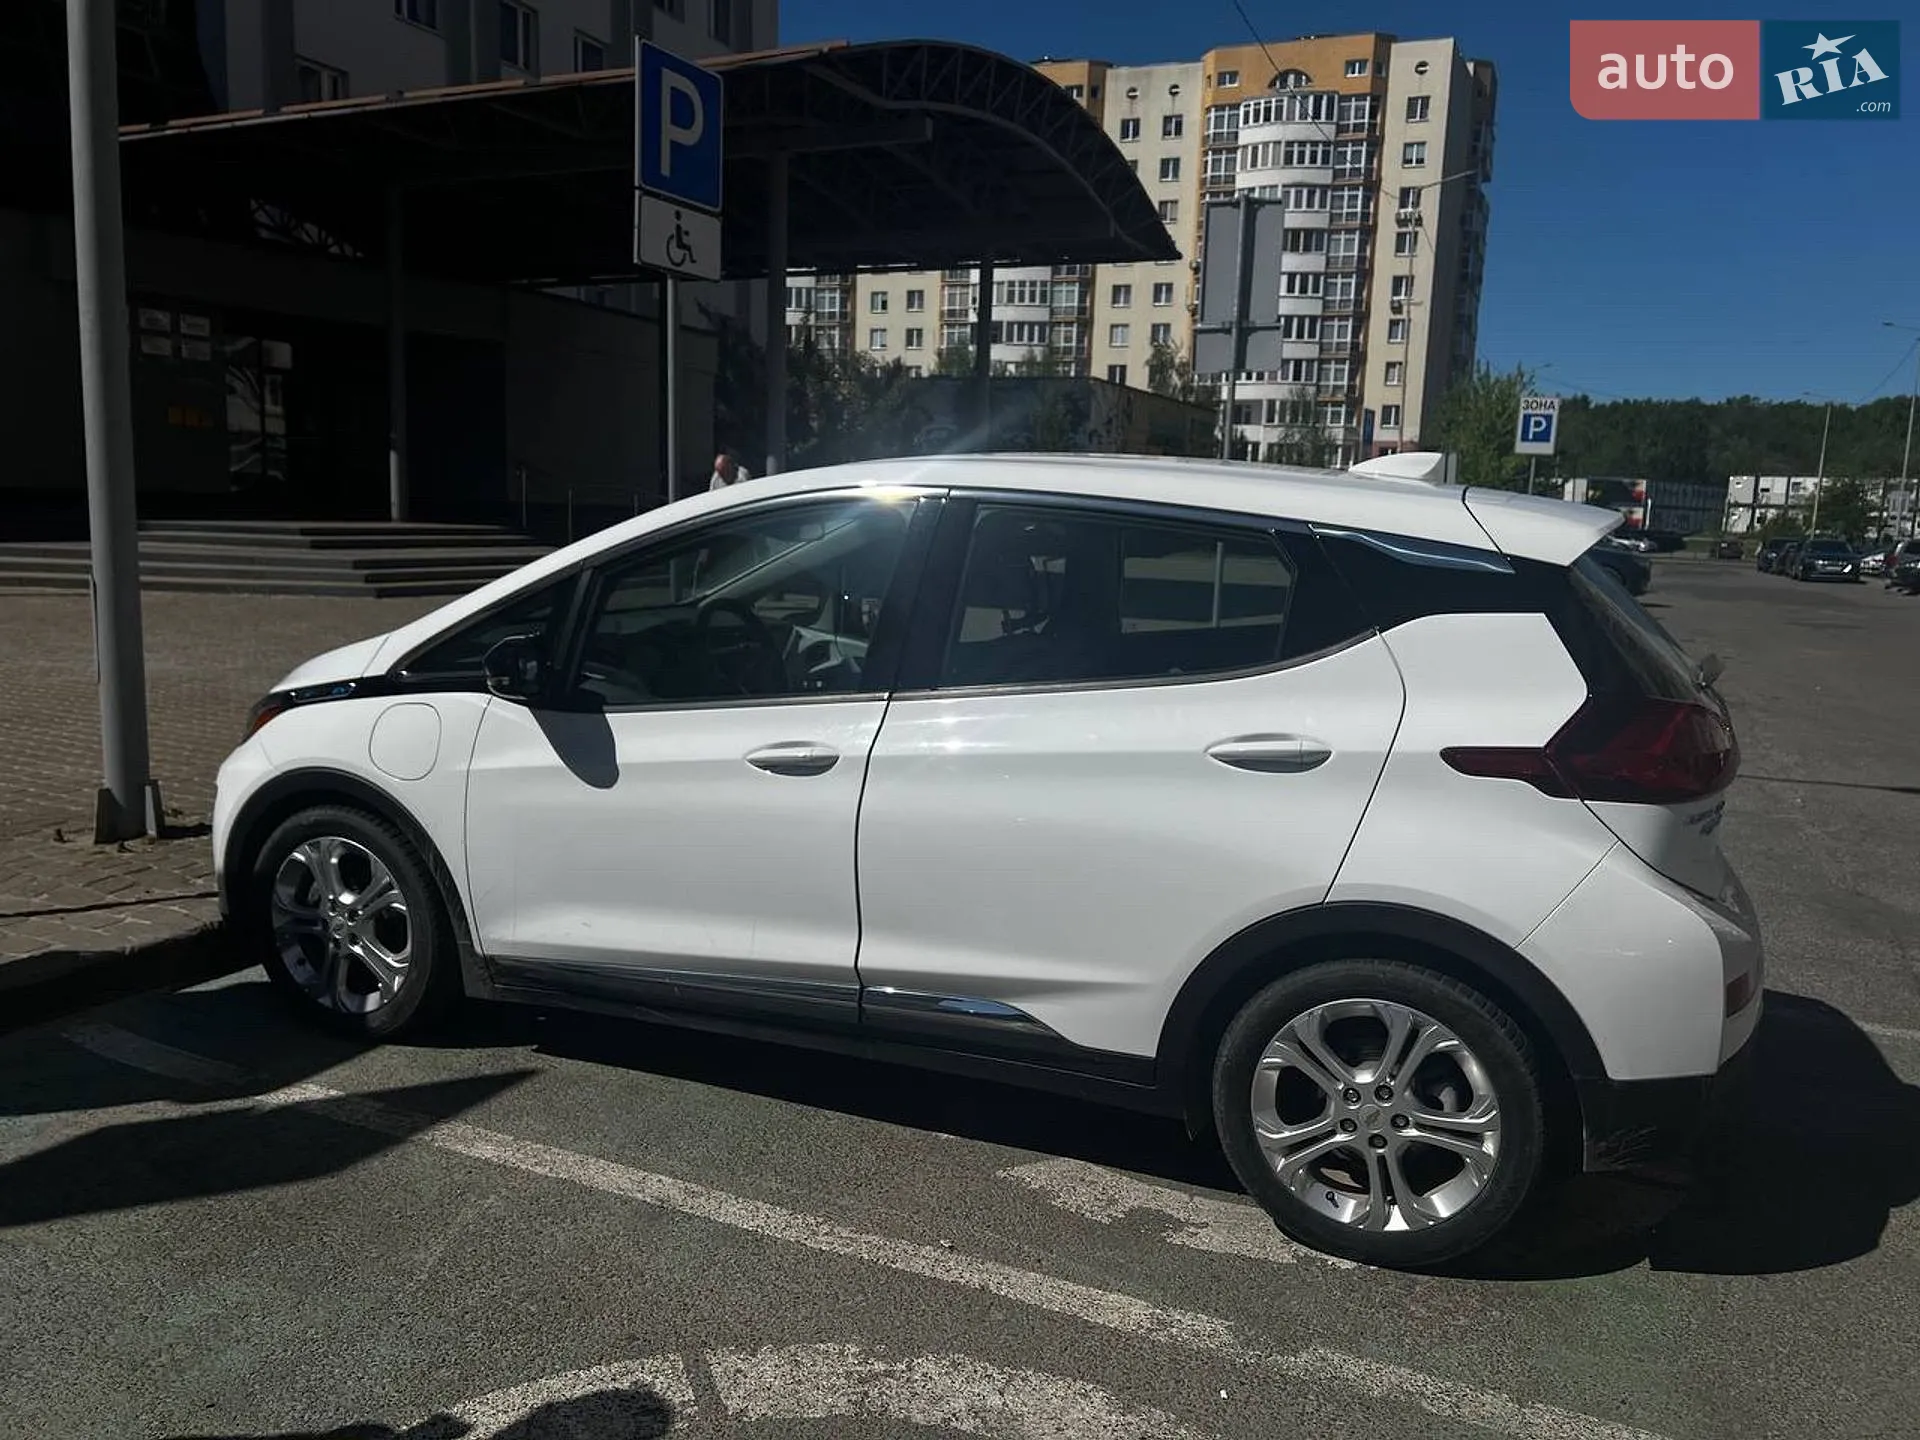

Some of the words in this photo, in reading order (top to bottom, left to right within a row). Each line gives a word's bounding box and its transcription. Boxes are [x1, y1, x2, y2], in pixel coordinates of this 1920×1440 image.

[660, 66, 704, 177] P
[1522, 399, 1556, 409] ЗОНА
[1529, 416, 1547, 440] P
